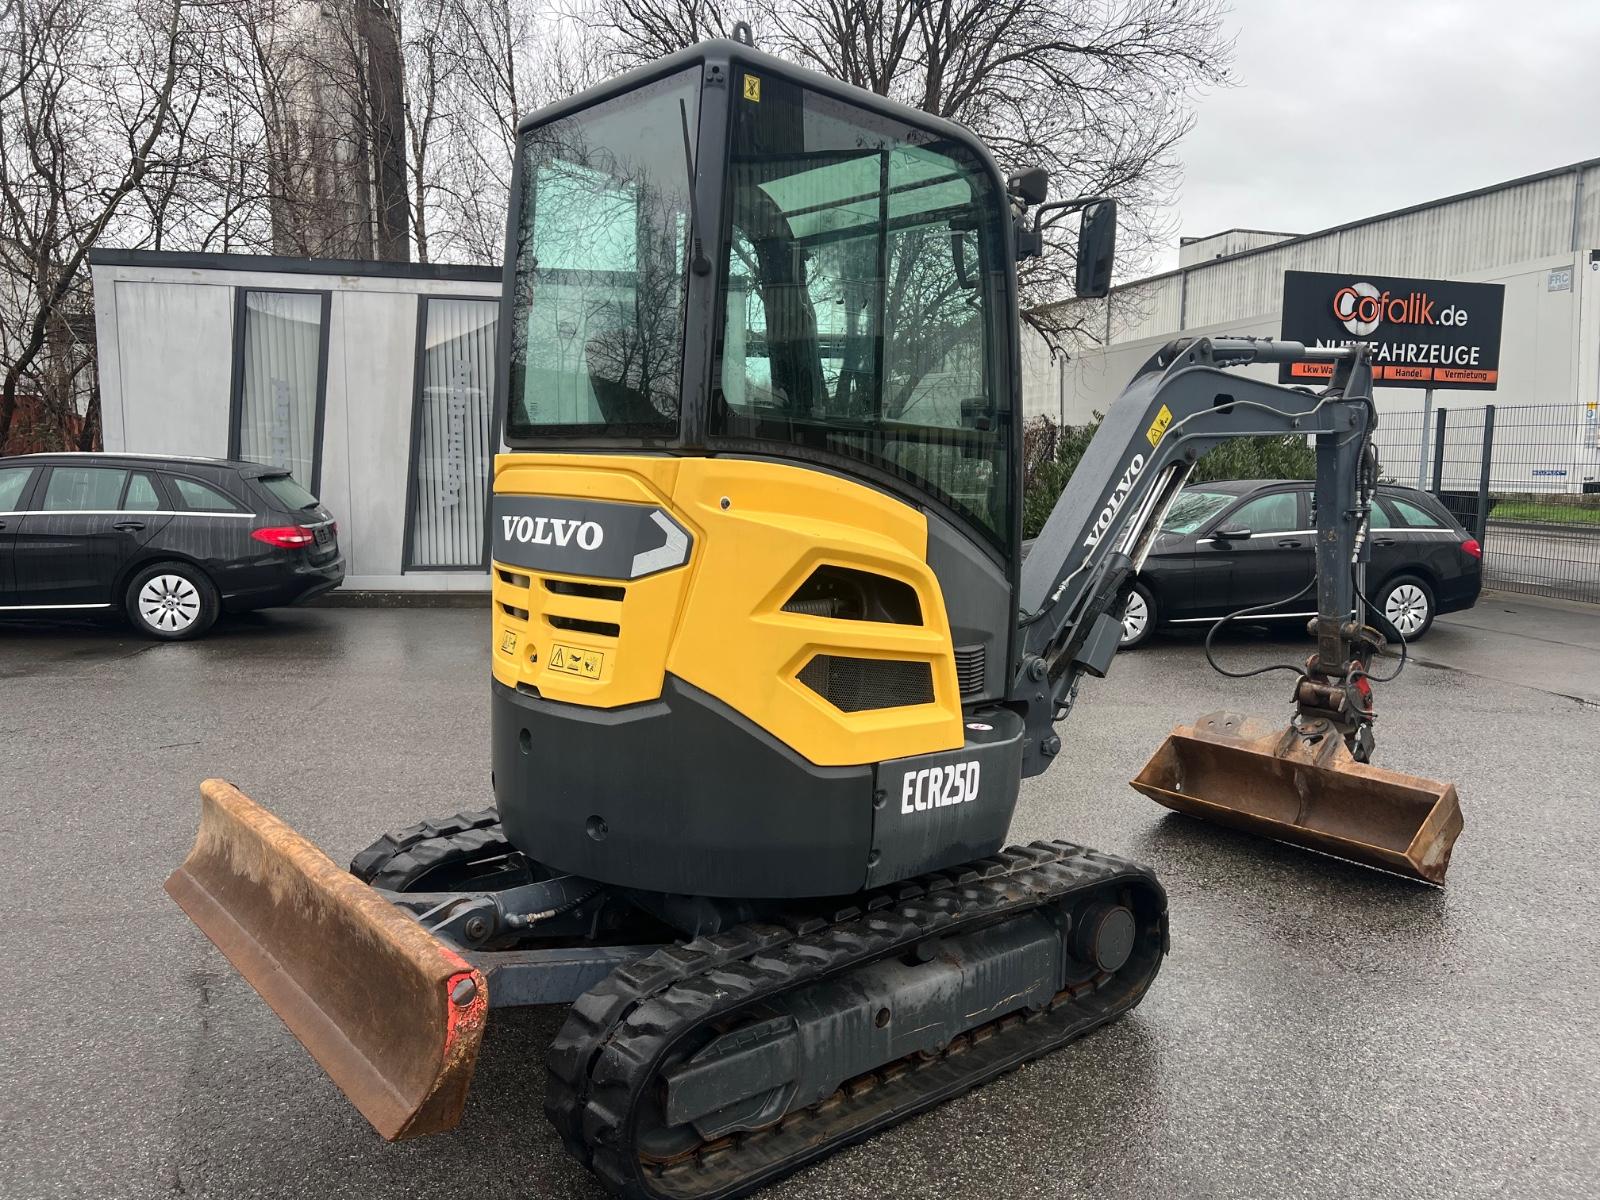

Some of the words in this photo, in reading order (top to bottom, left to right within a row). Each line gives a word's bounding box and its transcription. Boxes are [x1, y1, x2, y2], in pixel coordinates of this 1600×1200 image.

[1333, 287, 1468, 326] Cofalik.de
[1316, 338, 1480, 366] FAHRZEUGE
[1302, 364, 1319, 374] Lkw
[1395, 368, 1422, 378] Handel
[1444, 370, 1487, 381] Vermietung
[1083, 454, 1144, 547] VOLVO
[502, 515, 604, 551] VOLVO
[901, 760, 980, 815] ECR25D
